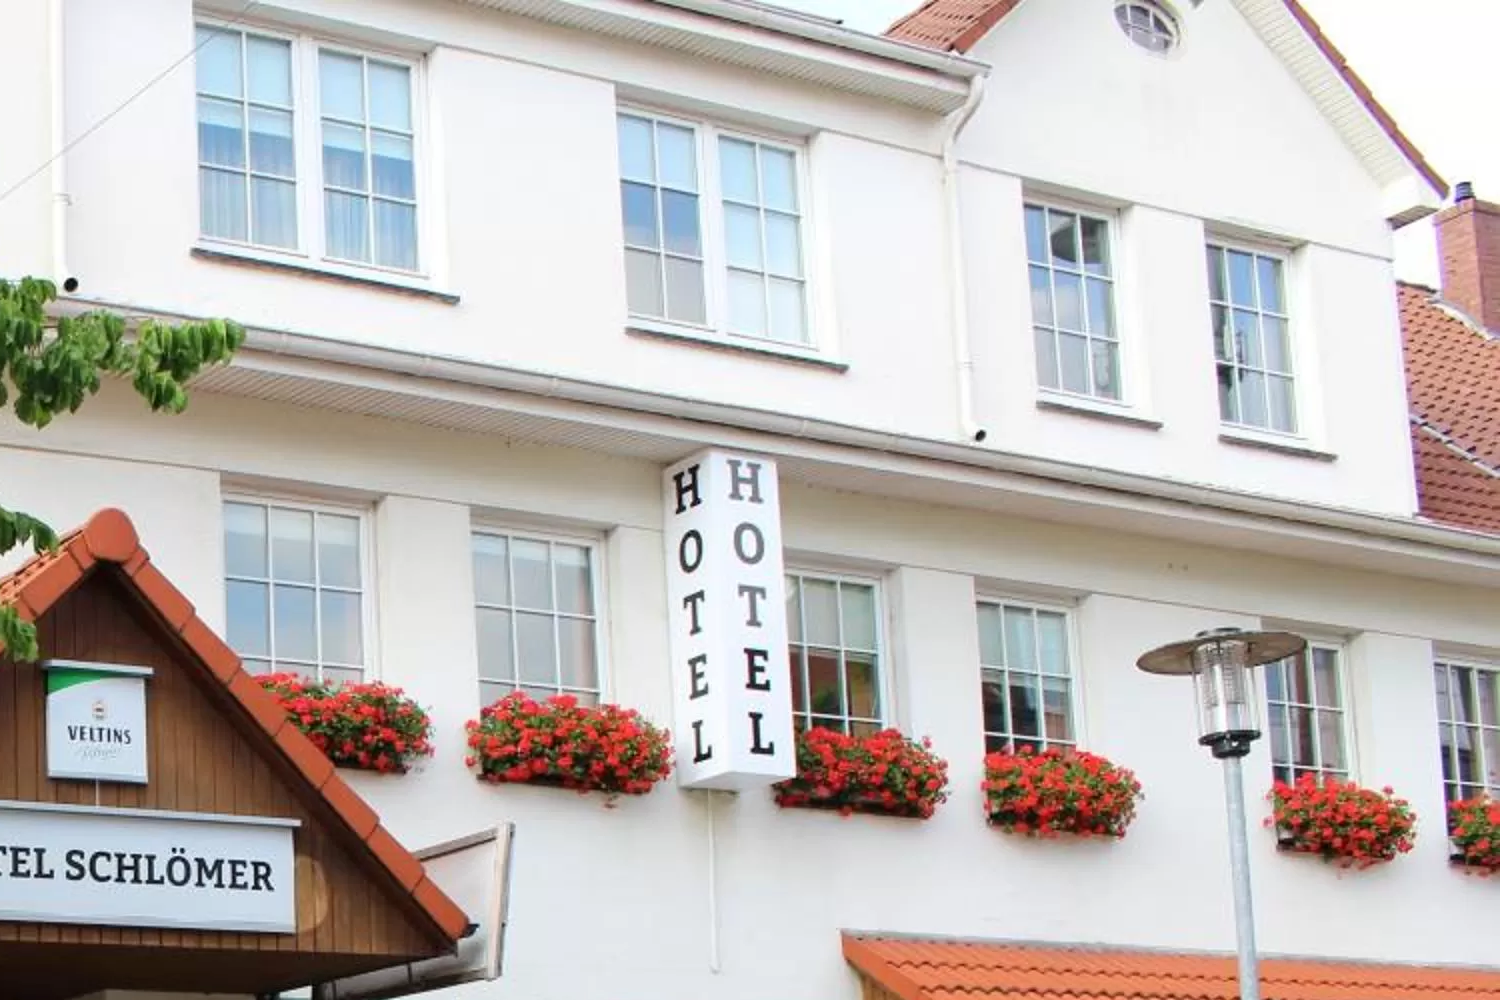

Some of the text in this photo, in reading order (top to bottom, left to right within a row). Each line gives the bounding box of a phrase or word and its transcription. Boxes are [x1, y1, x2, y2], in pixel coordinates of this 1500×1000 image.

[673, 463, 712, 764] HOTEL
[726, 458, 775, 755] HOTEL
[67, 725, 132, 744] VELTINS
[64, 847, 274, 892] SCHLÖMER
